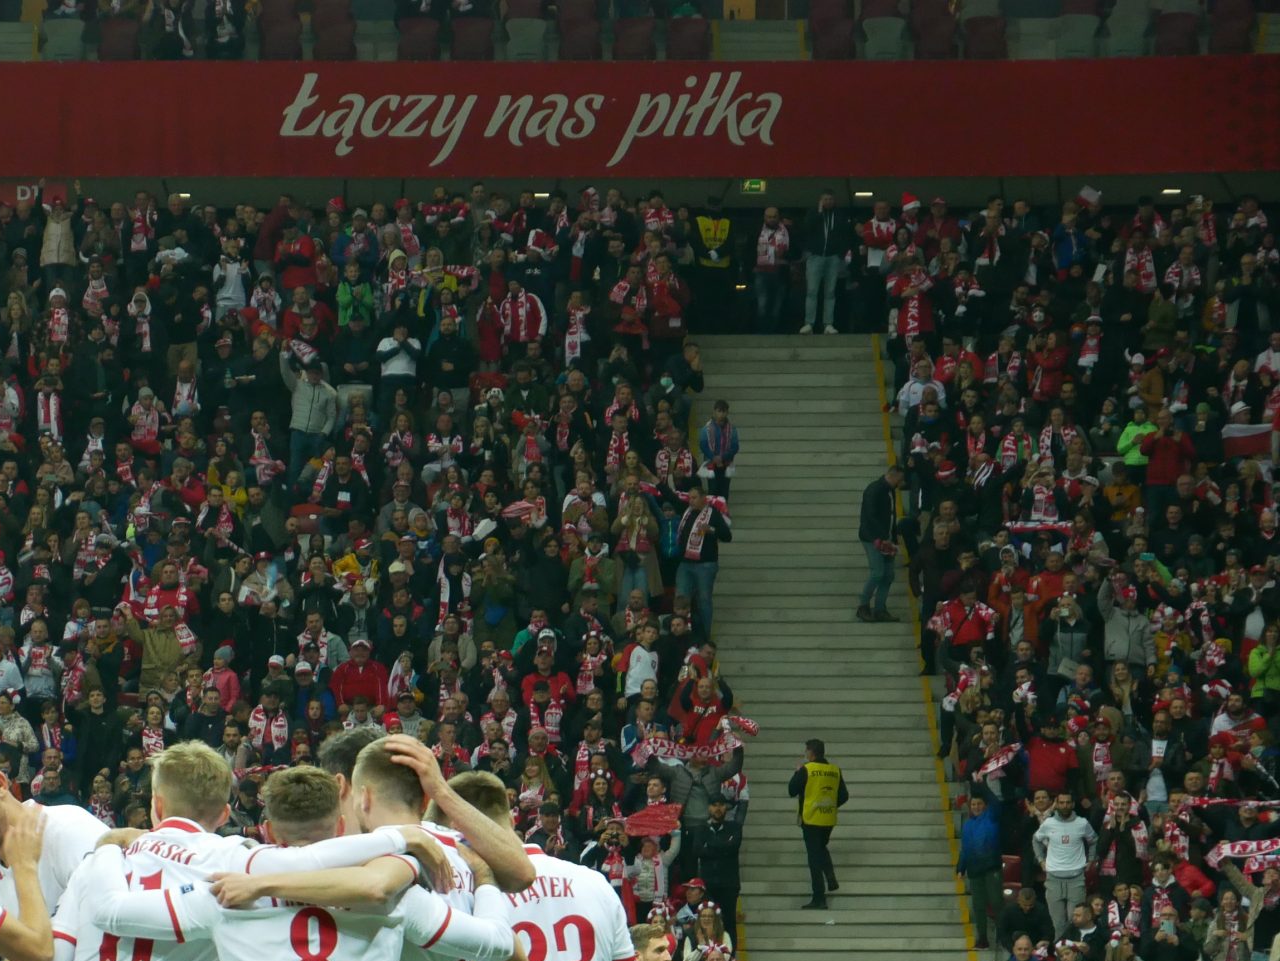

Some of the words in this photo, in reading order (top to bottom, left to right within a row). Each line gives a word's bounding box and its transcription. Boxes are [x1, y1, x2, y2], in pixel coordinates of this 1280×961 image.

[279, 72, 477, 167] Łączy
[483, 93, 605, 147] nas
[606, 71, 783, 168] piłka
